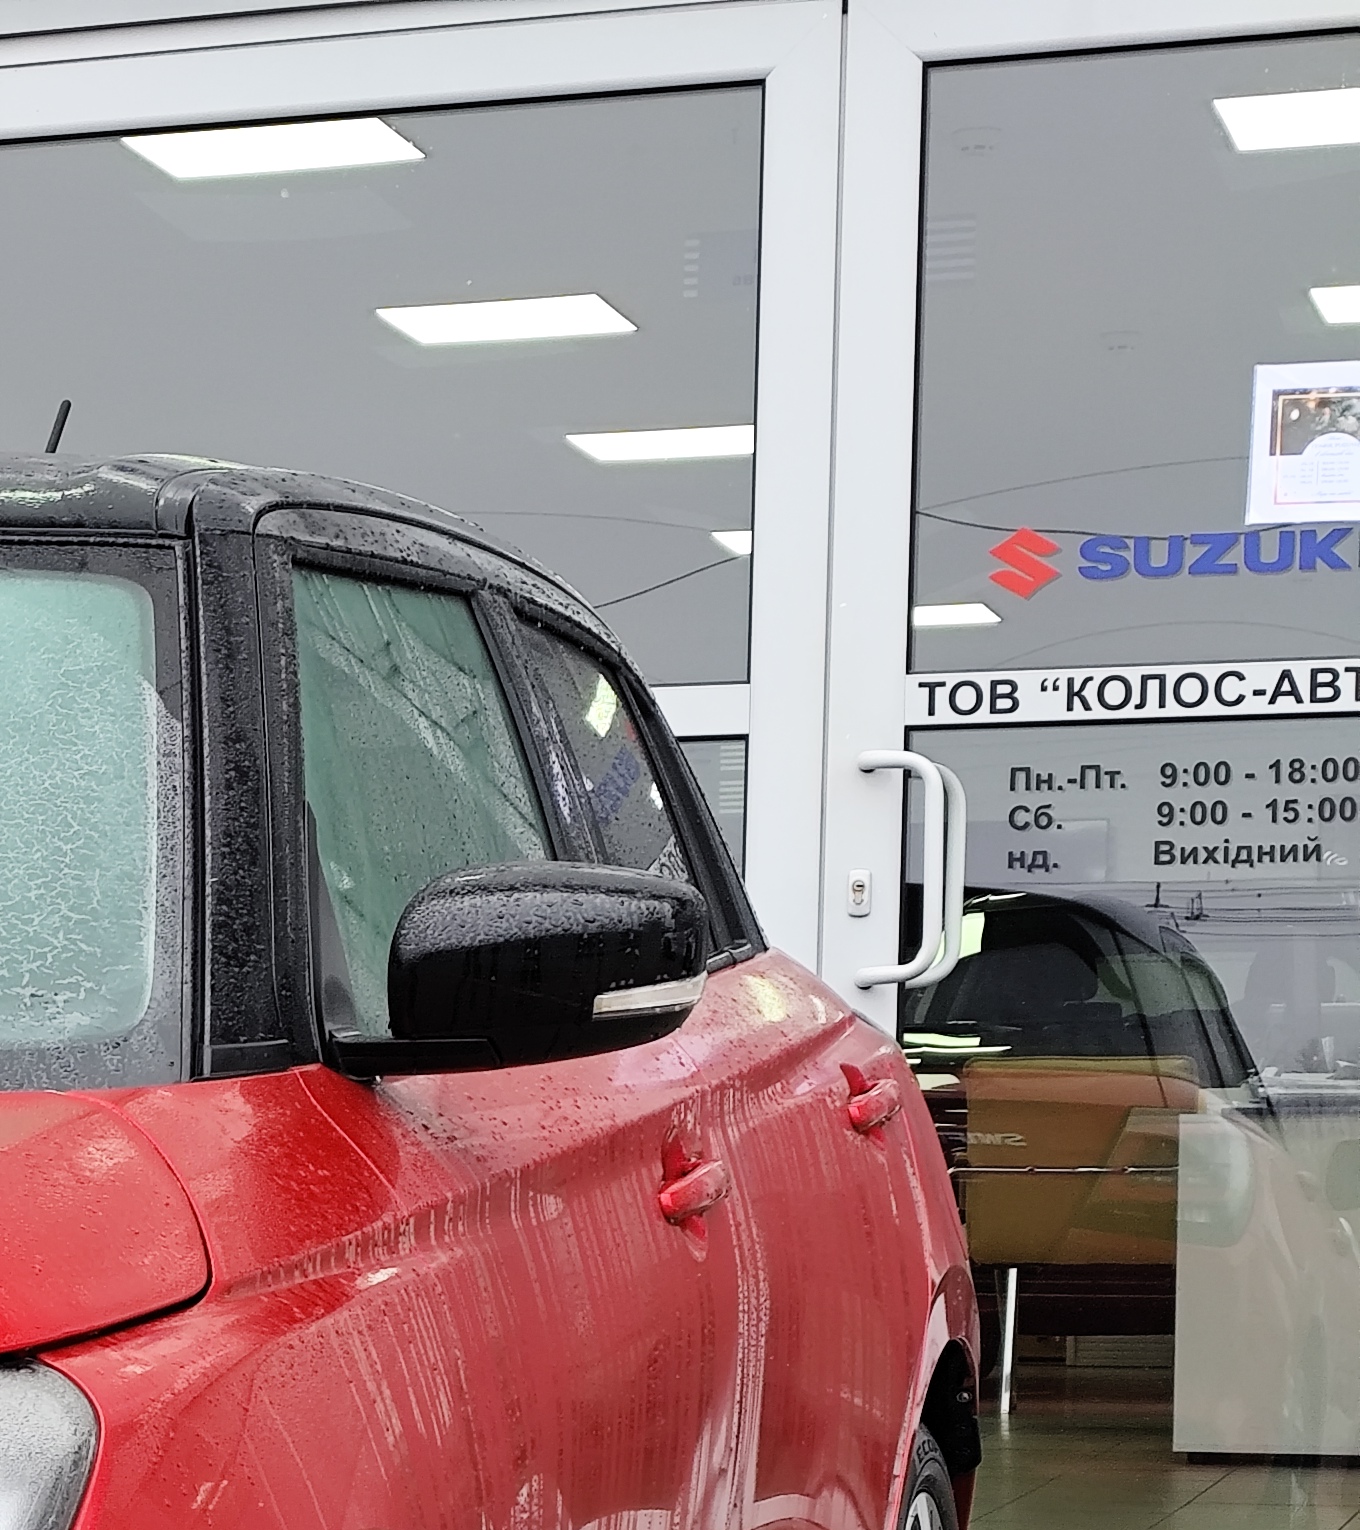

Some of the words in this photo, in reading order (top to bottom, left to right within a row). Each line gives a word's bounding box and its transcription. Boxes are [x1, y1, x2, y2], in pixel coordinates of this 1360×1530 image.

[1077, 527, 1360, 582] SUZUK
[918, 678, 1020, 716] ТОВ
[1009, 764, 1128, 791] Пн.-Пт.
[1159, 760, 1232, 788] 9:00
[1268, 757, 1360, 784] 18:00
[1008, 804, 1063, 831] Сб.
[1156, 800, 1228, 827] 9:00
[1265, 796, 1358, 824] 15:00
[1007, 850, 1060, 873] нд.
[1153, 836, 1322, 869] Вихідний
